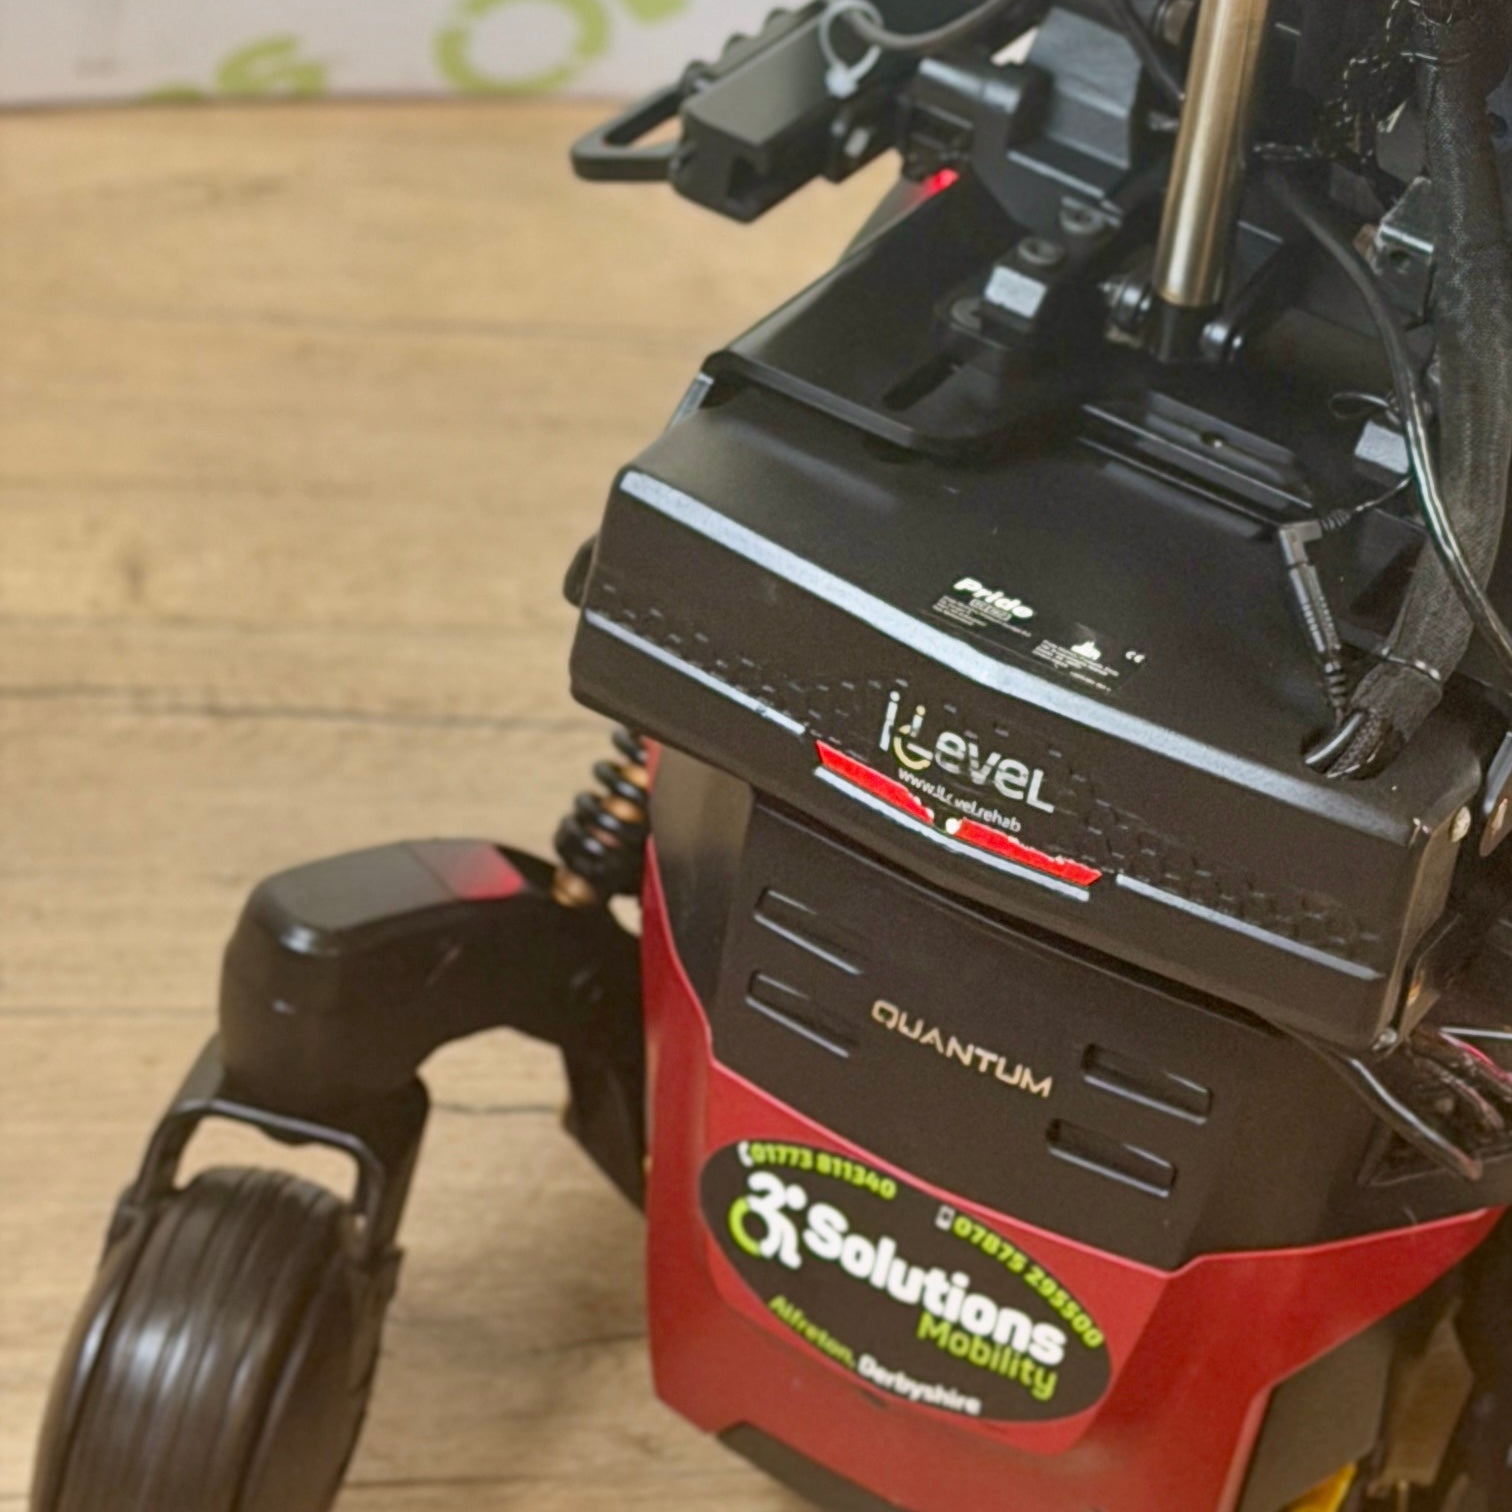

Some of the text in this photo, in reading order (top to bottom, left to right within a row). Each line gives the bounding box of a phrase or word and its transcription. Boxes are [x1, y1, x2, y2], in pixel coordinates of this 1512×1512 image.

[953, 576, 1034, 619] Pride
[871, 998, 1053, 1098] QUANTUM
[750, 1141, 813, 1171] 01773
[803, 1202, 1068, 1367] Solutions
[857, 1352, 983, 1417] Derbyshire
[916, 1310, 1058, 1401] Mobility
